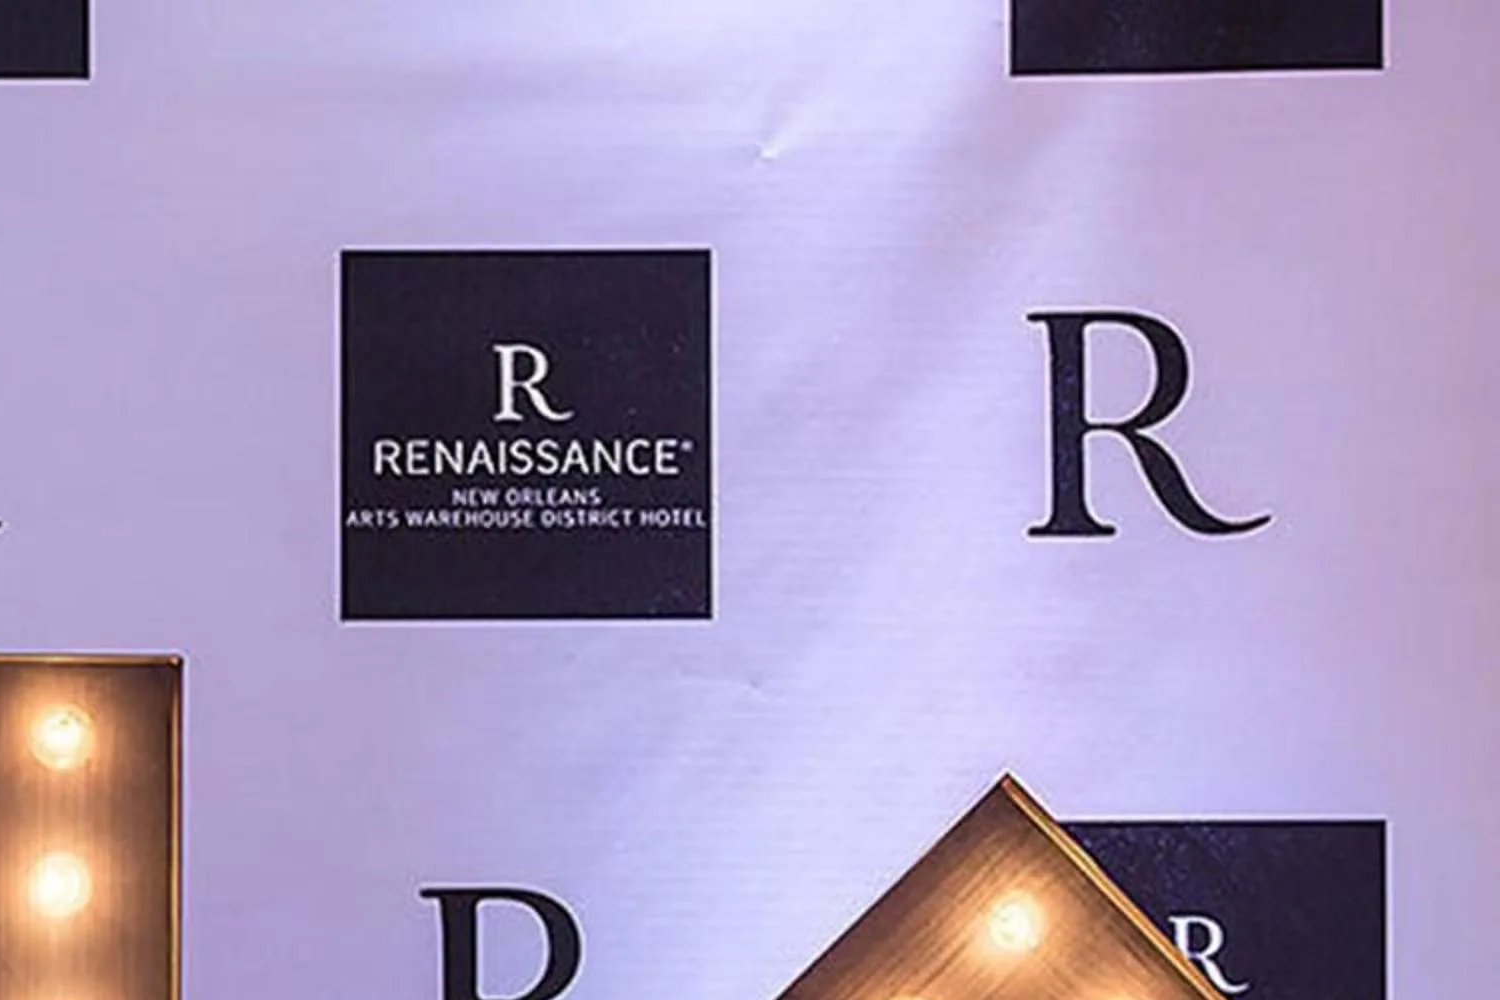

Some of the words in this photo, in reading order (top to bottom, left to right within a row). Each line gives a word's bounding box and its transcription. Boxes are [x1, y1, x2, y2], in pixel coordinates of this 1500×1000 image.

[493, 344, 575, 422] R
[1025, 309, 1274, 538] R
[345, 509, 399, 528] ARTS
[405, 509, 534, 528] WAREHOUSE
[541, 509, 631, 528] DISTRICT
[640, 509, 707, 528] HOTEL
[452, 488, 499, 505] NEW
[505, 488, 602, 506] ORLEANS
[1168, 915, 1250, 994] R
